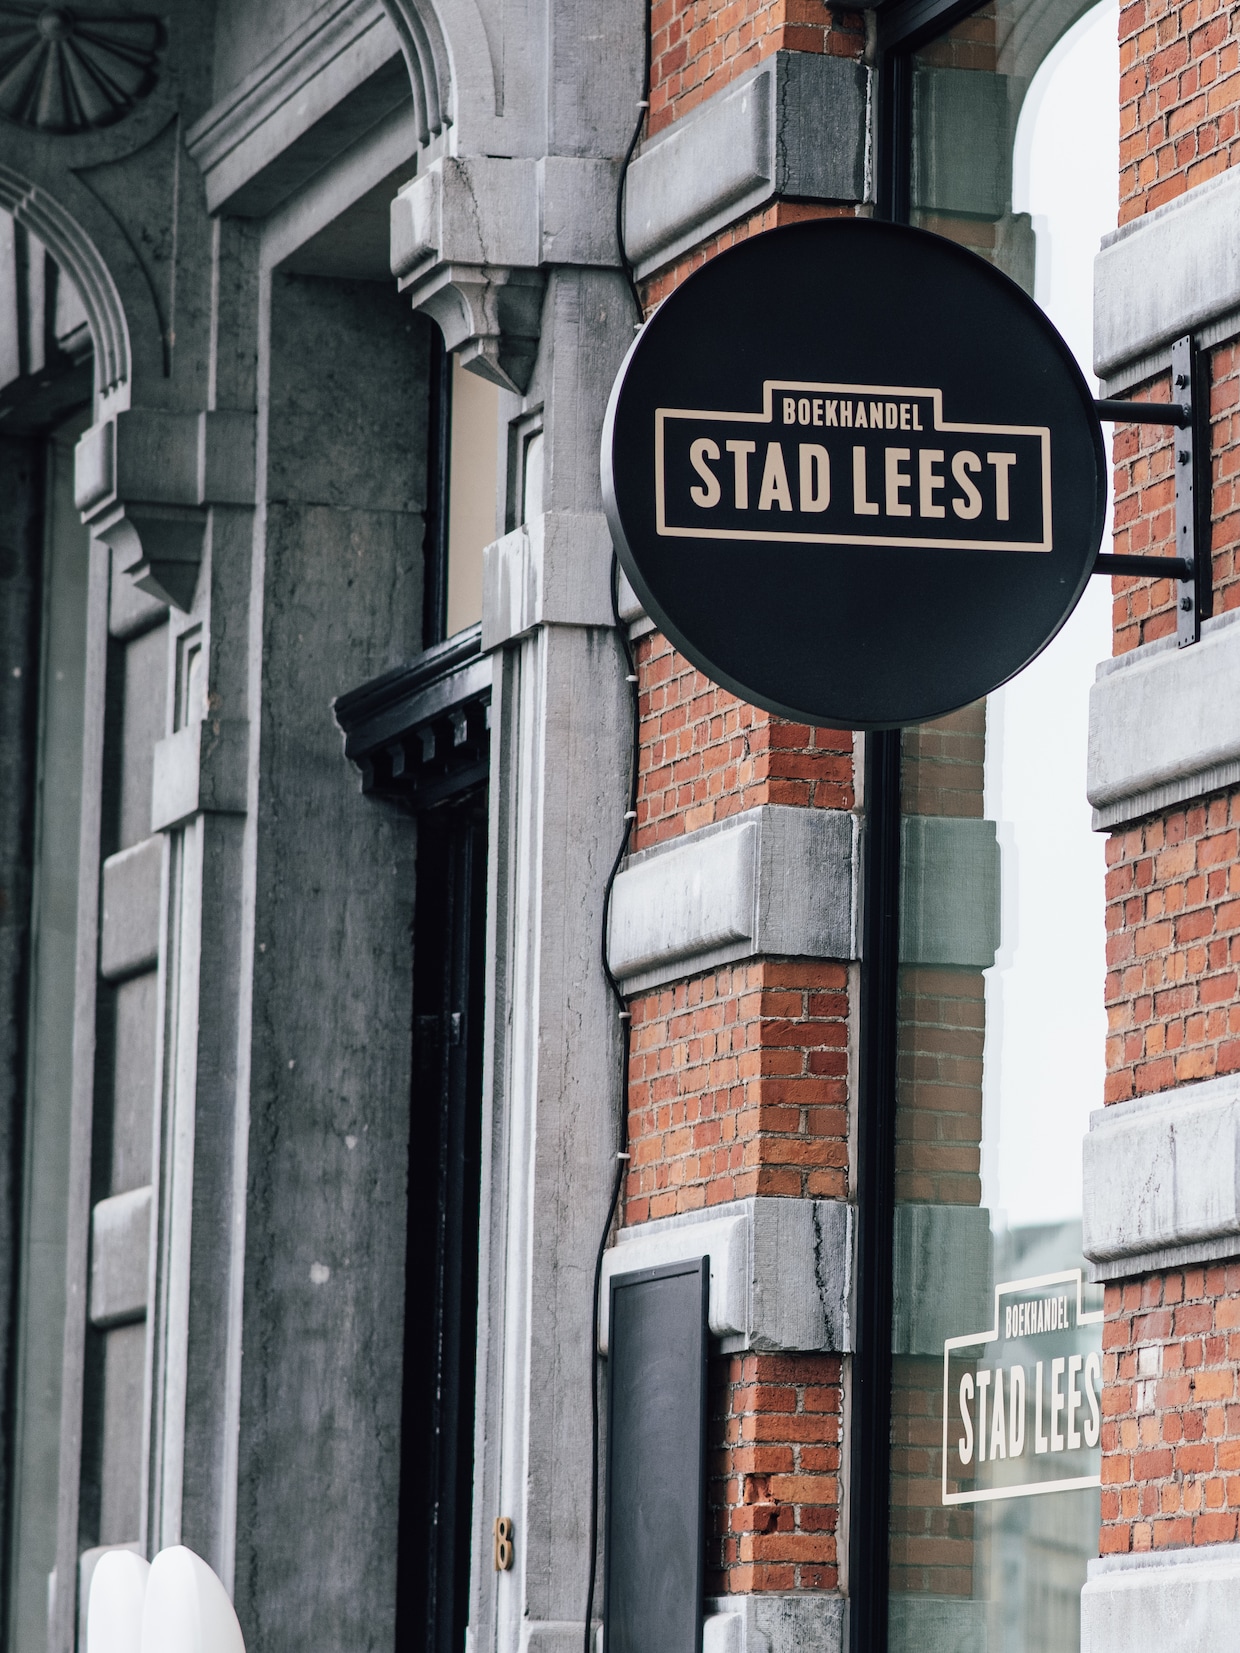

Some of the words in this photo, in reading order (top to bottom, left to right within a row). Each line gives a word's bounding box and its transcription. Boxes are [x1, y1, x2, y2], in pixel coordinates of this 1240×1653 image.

[783, 398, 924, 432] BOEKHANDEL
[689, 438, 831, 513] STAD
[852, 446, 1017, 522] LEEST
[1005, 1296, 1070, 1339] BOEKHANDEL
[959, 1364, 1026, 1465] STAD
[1035, 1352, 1101, 1454] LEES
